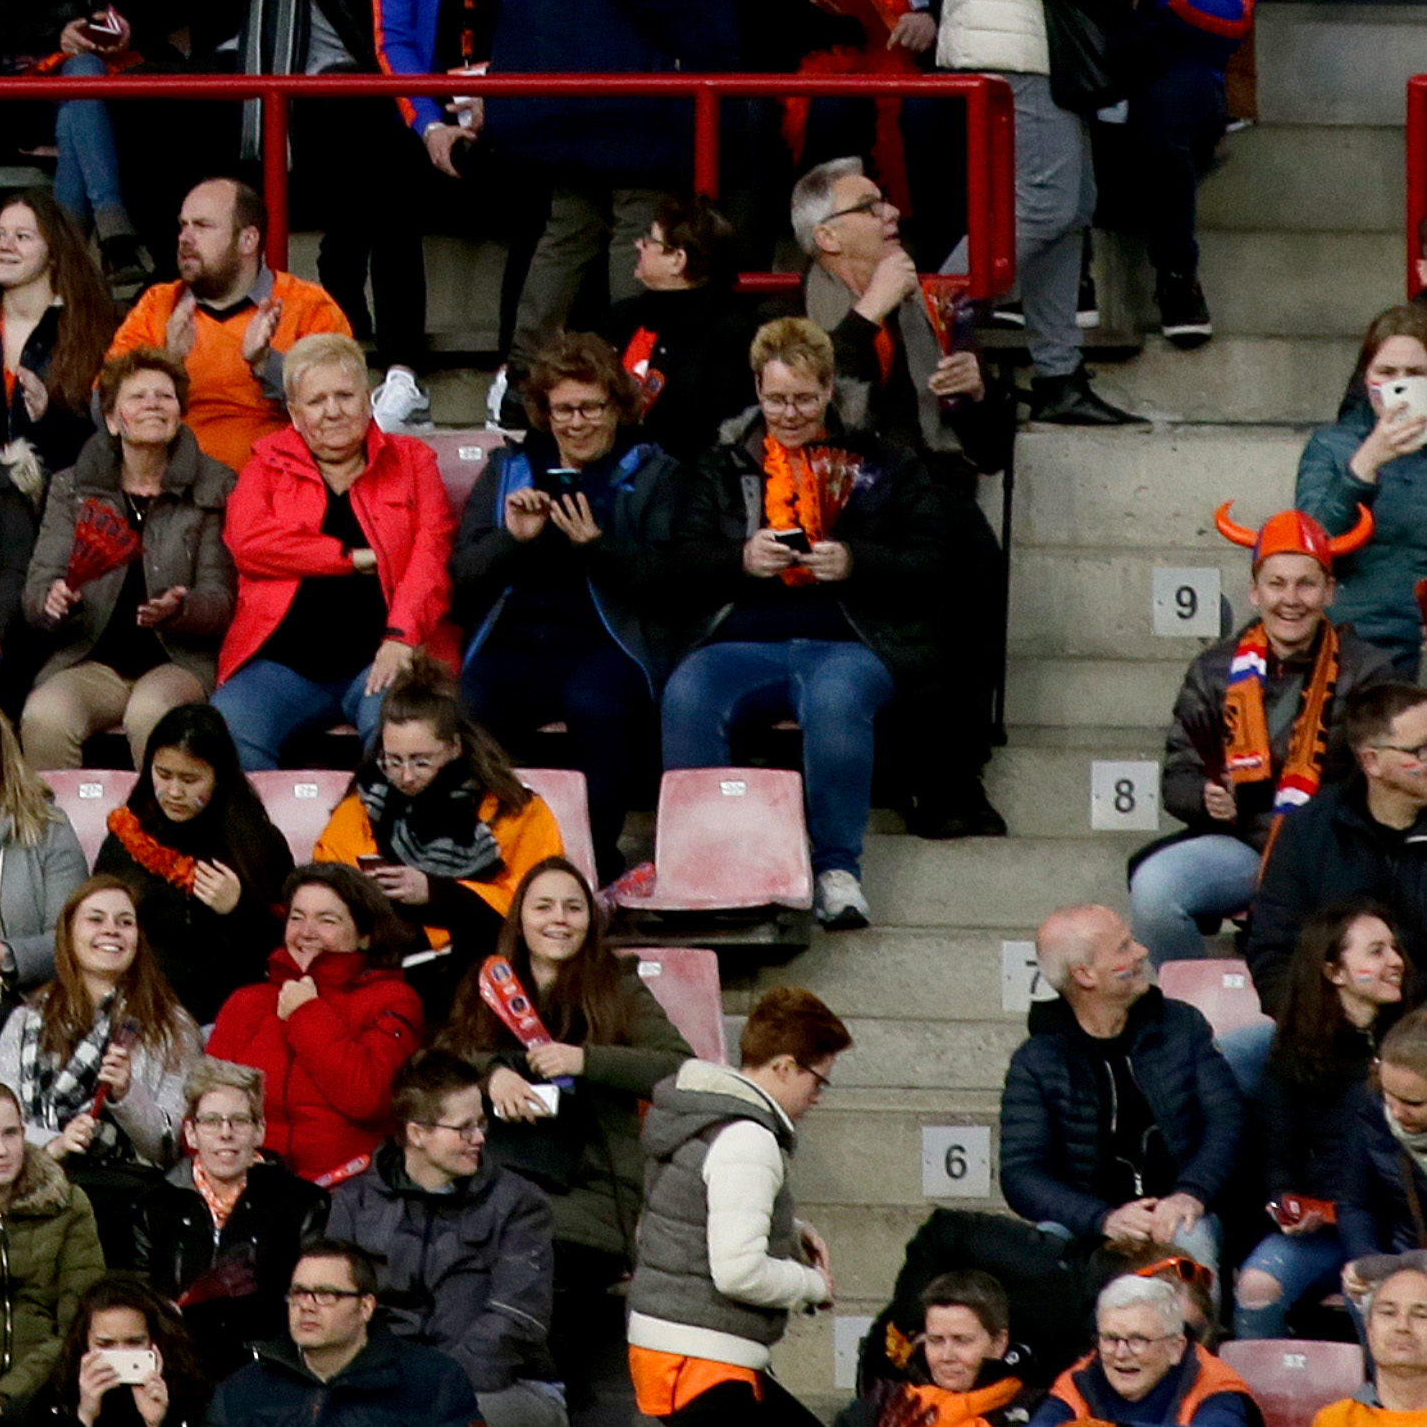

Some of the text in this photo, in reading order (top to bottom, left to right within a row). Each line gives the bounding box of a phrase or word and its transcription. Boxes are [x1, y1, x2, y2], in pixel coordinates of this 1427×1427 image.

[1175, 585, 1198, 620] 9
[1114, 778, 1136, 814] 8
[1024, 960, 1042, 995] 7
[944, 1143, 968, 1180] 6
